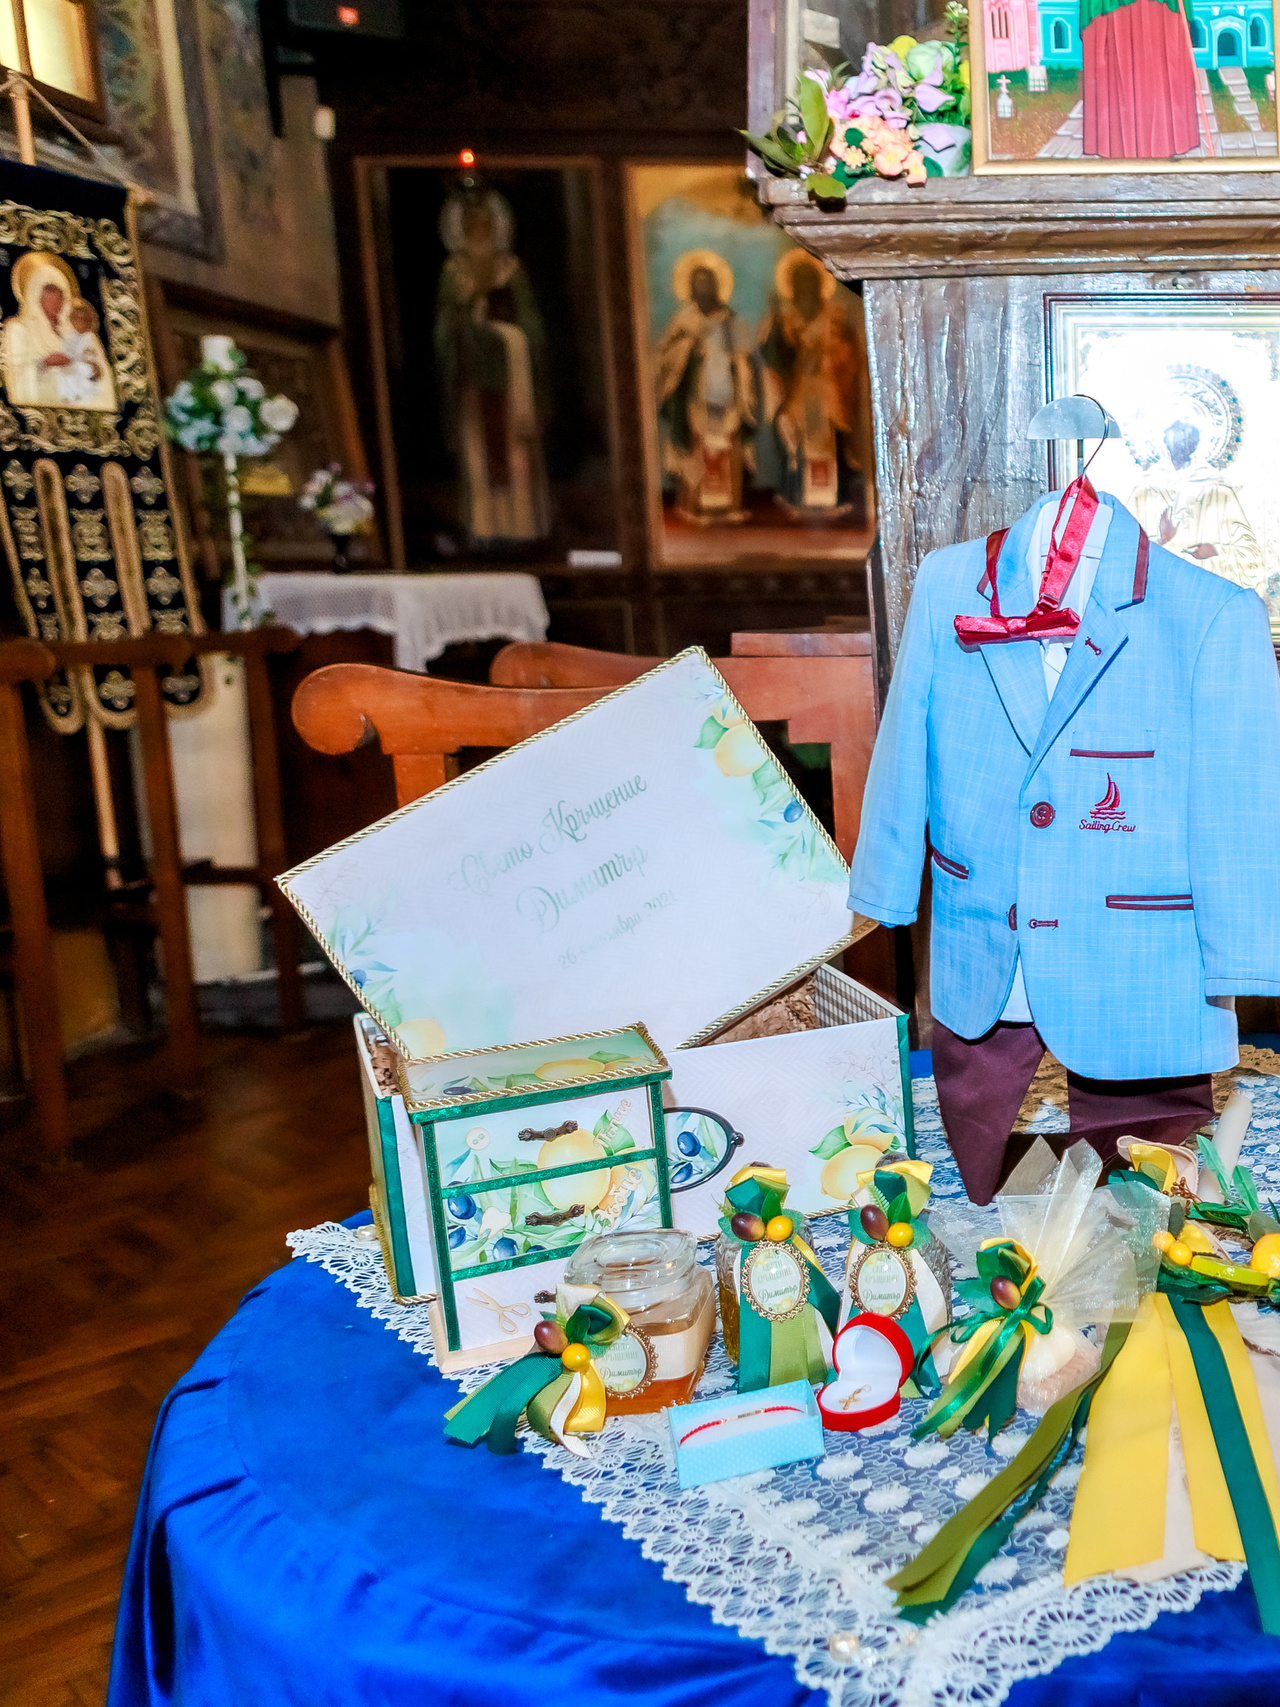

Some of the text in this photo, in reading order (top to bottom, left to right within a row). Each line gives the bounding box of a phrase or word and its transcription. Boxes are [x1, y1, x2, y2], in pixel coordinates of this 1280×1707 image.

[538, 775, 648, 855] Кръщение
[1079, 819, 1137, 833] Sailing Crew
[515, 844, 649, 934] Димитър
